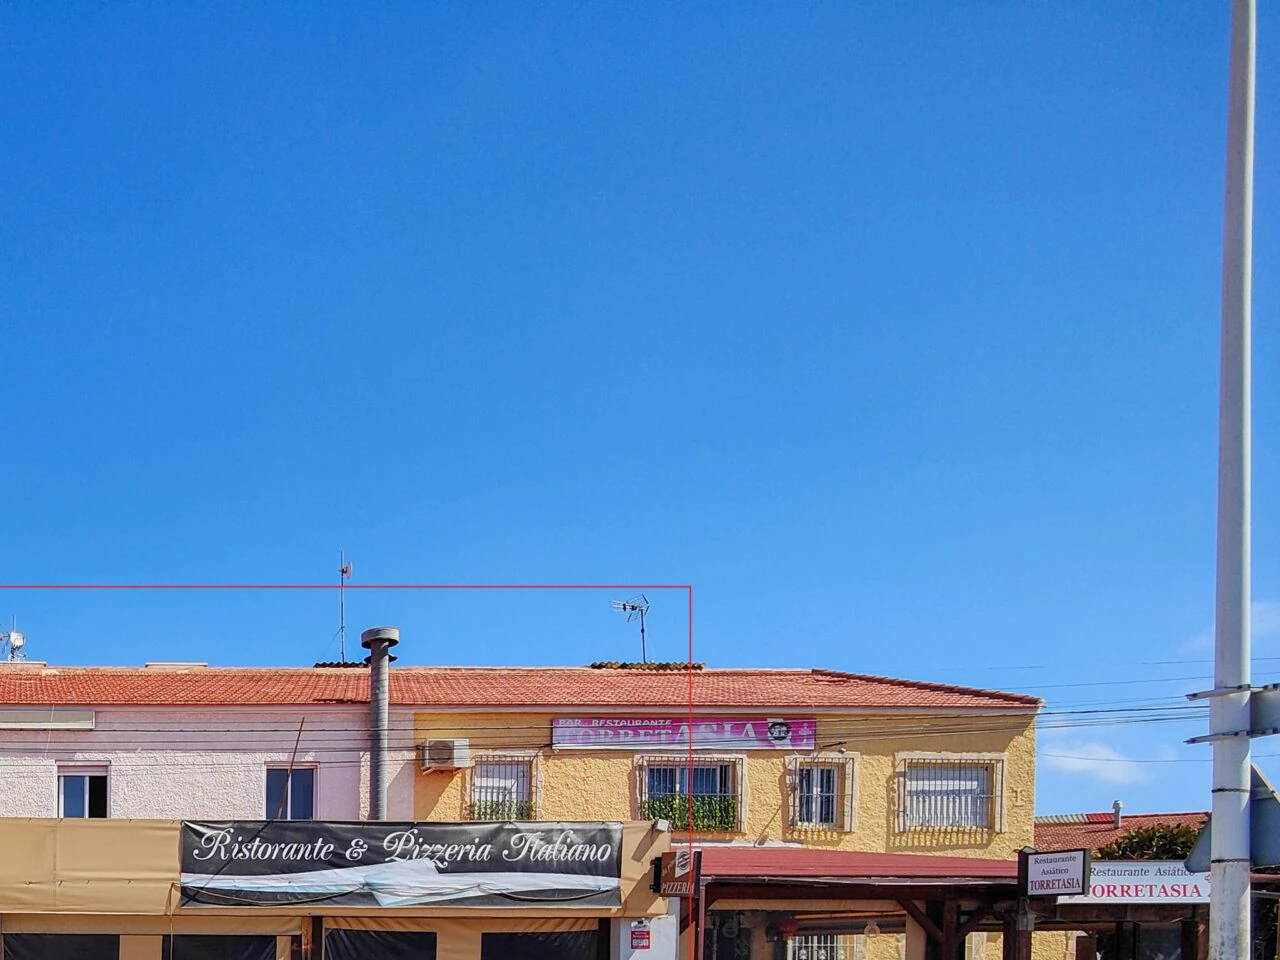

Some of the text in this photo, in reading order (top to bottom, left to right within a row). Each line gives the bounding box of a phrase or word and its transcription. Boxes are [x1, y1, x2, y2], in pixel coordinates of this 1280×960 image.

[558, 719, 581, 727] BAR
[591, 719, 673, 727] RESTAURANTE
[193, 827, 612, 868] Ristorante & Pizzeria Italiano
[1034, 855, 1077, 865] Restaurante
[1040, 867, 1069, 876] Asiático
[1090, 866, 1150, 877] Restaurante
[1030, 877, 1080, 891] TORRETASIA
